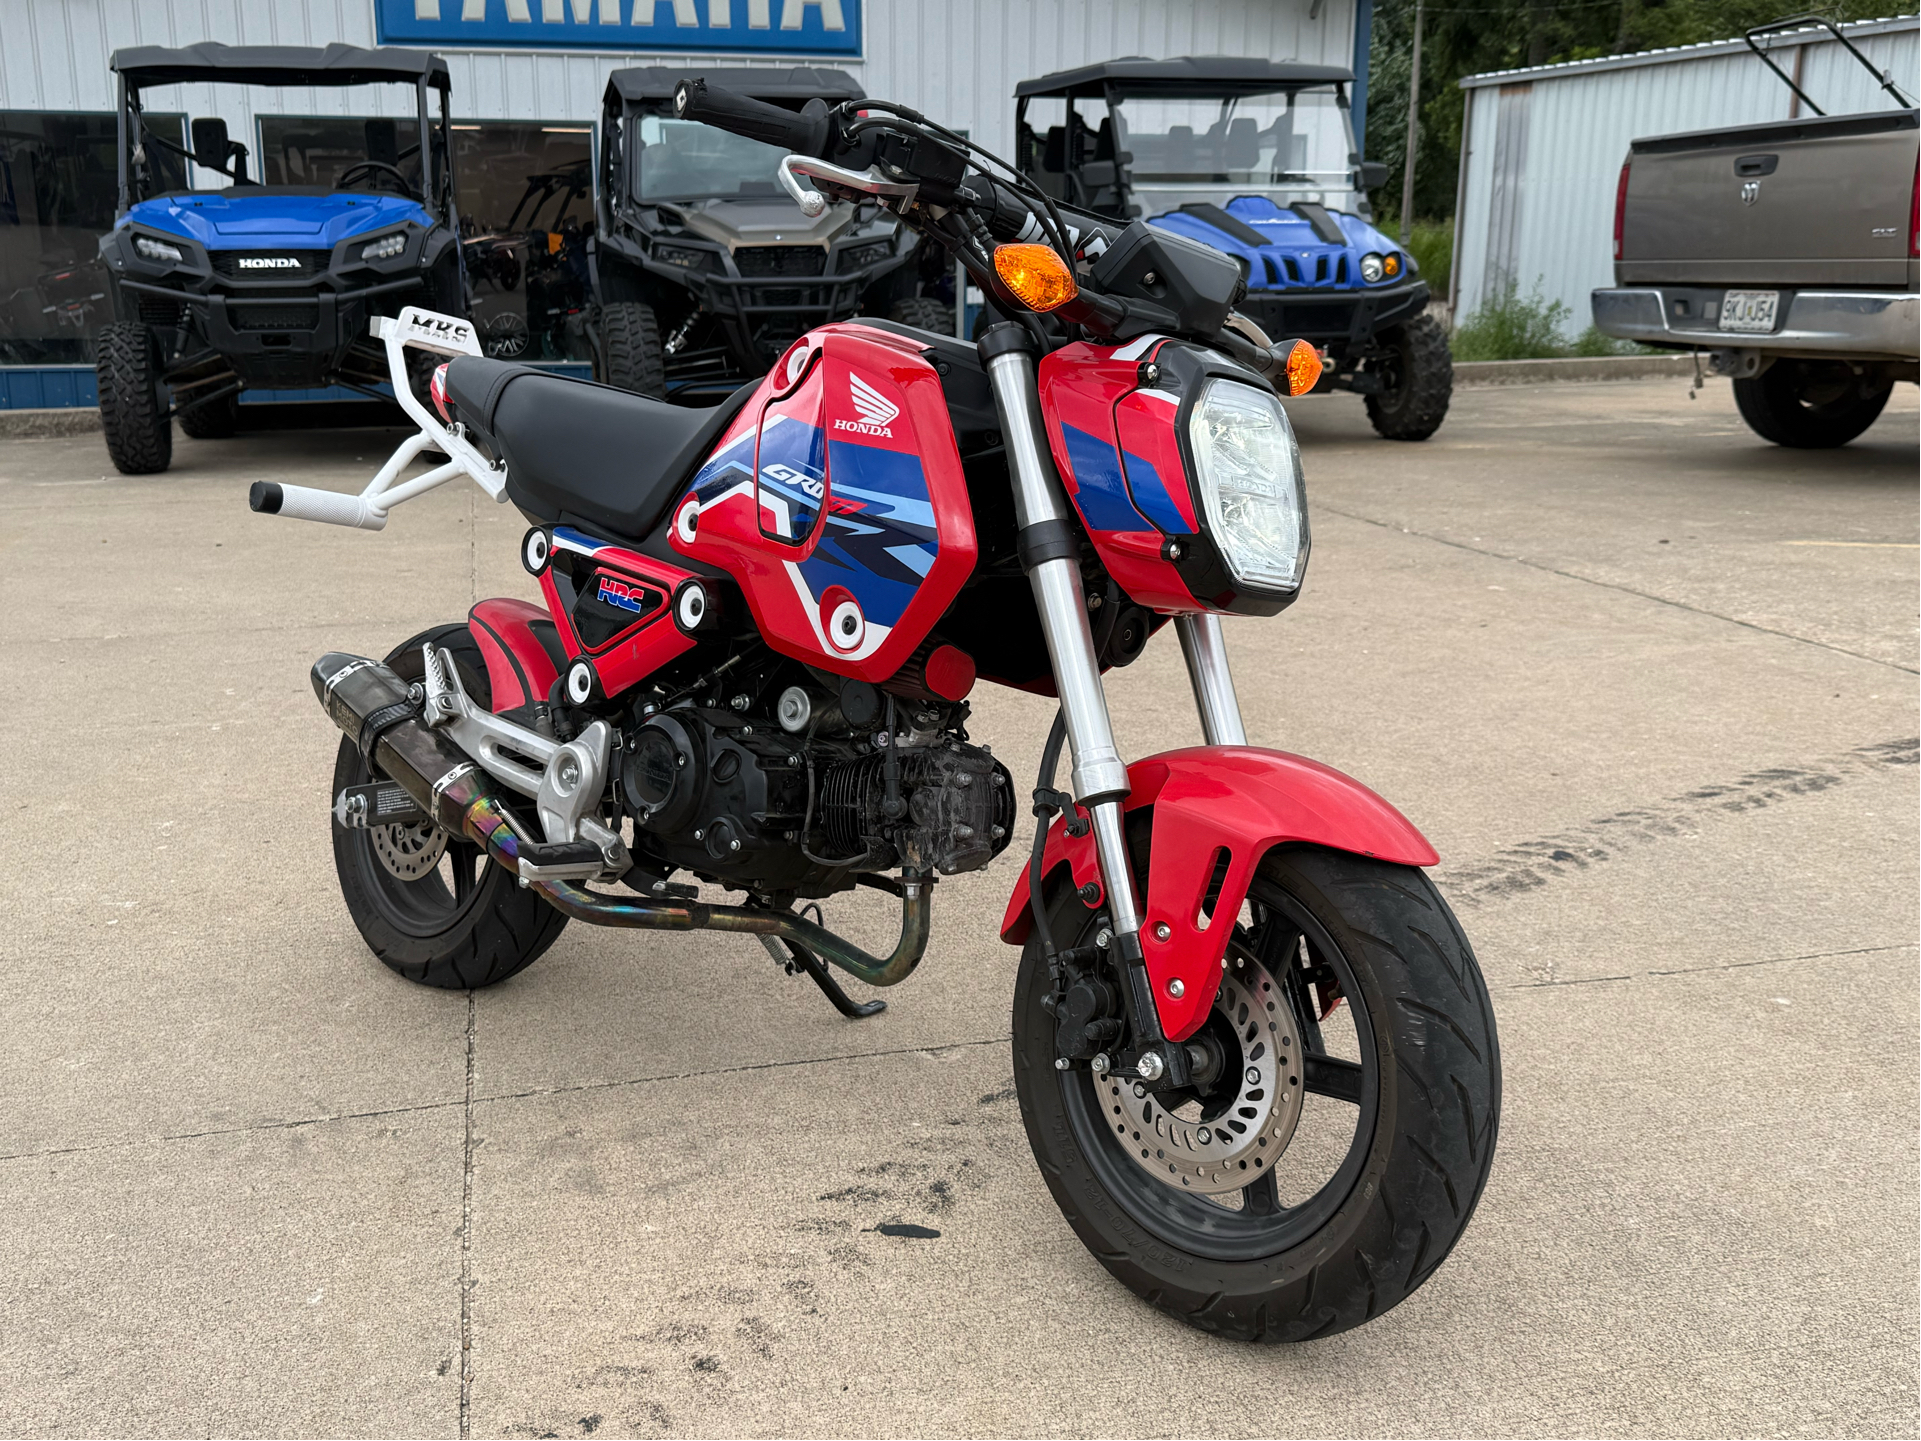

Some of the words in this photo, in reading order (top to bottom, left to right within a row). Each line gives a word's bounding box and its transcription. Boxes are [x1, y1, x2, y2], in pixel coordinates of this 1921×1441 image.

[239, 258, 302, 269] HONDA
[833, 418, 893, 438] HONDA
[597, 577, 644, 613] HRC
[336, 700, 355, 724] KEMI
[336, 709, 358, 736] MOTO
